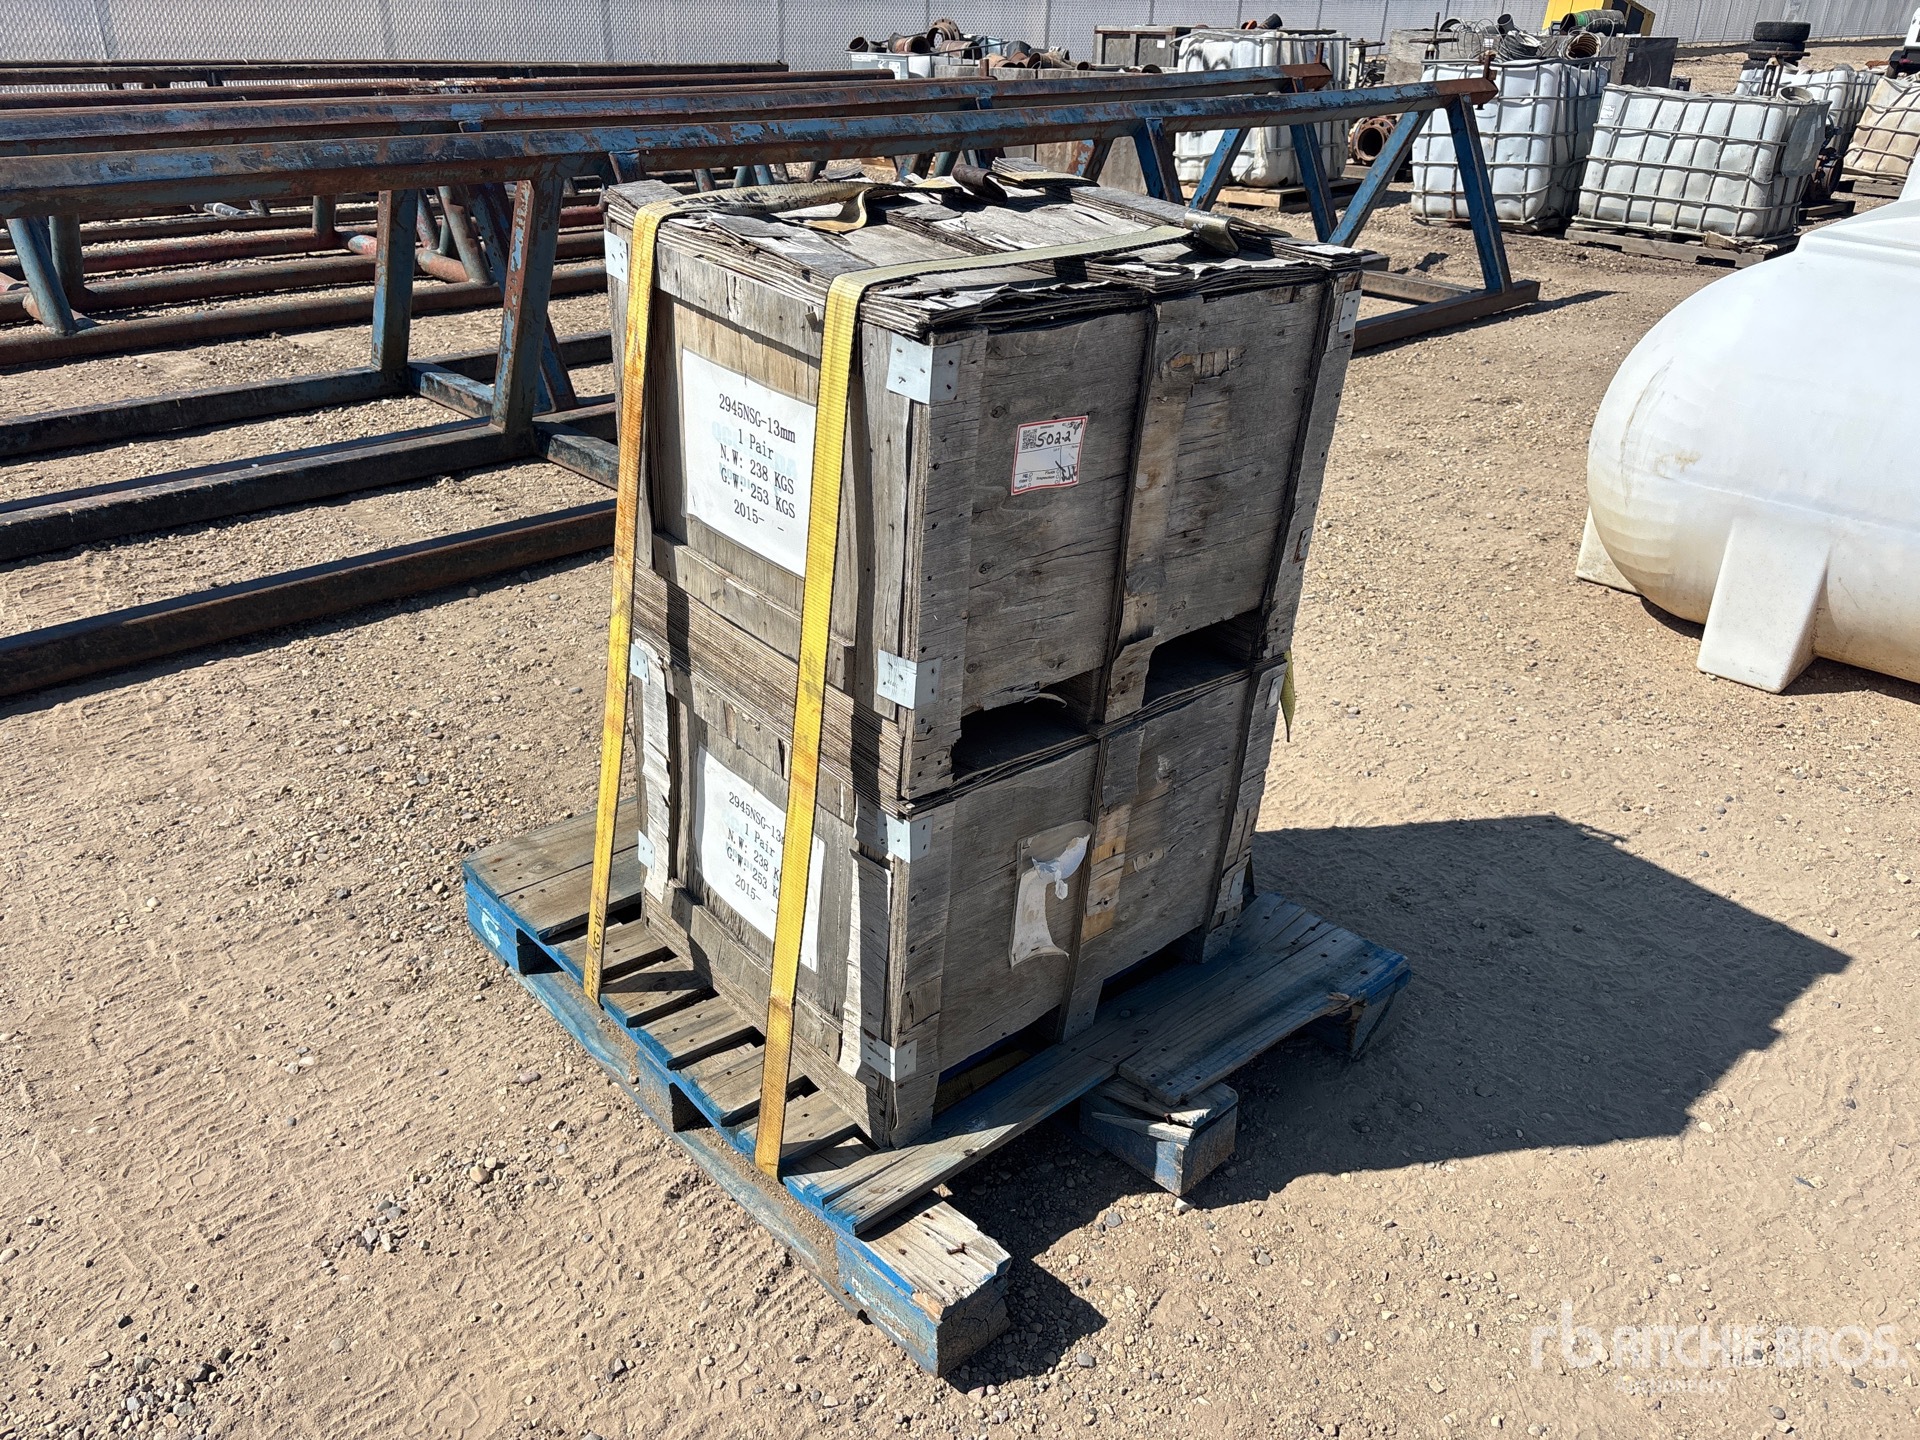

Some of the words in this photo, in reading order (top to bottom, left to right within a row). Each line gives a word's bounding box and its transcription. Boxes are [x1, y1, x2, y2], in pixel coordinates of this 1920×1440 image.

[718, 394, 796, 444] 2945NSG-13mm
[738, 428, 744, 446] 1
[749, 433, 774, 461] Pair
[750, 459, 769, 482] 238
[774, 471, 795, 495] KGS
[734, 499, 765, 524] 2015-
[750, 483, 769, 506] 253
[775, 496, 796, 519] KGS
[728, 792, 785, 845] 2945NSG-13
[745, 823, 751, 836] 1
[754, 831, 776, 857] Pair
[753, 850, 769, 872] 238
[752, 868, 768, 890] 253
